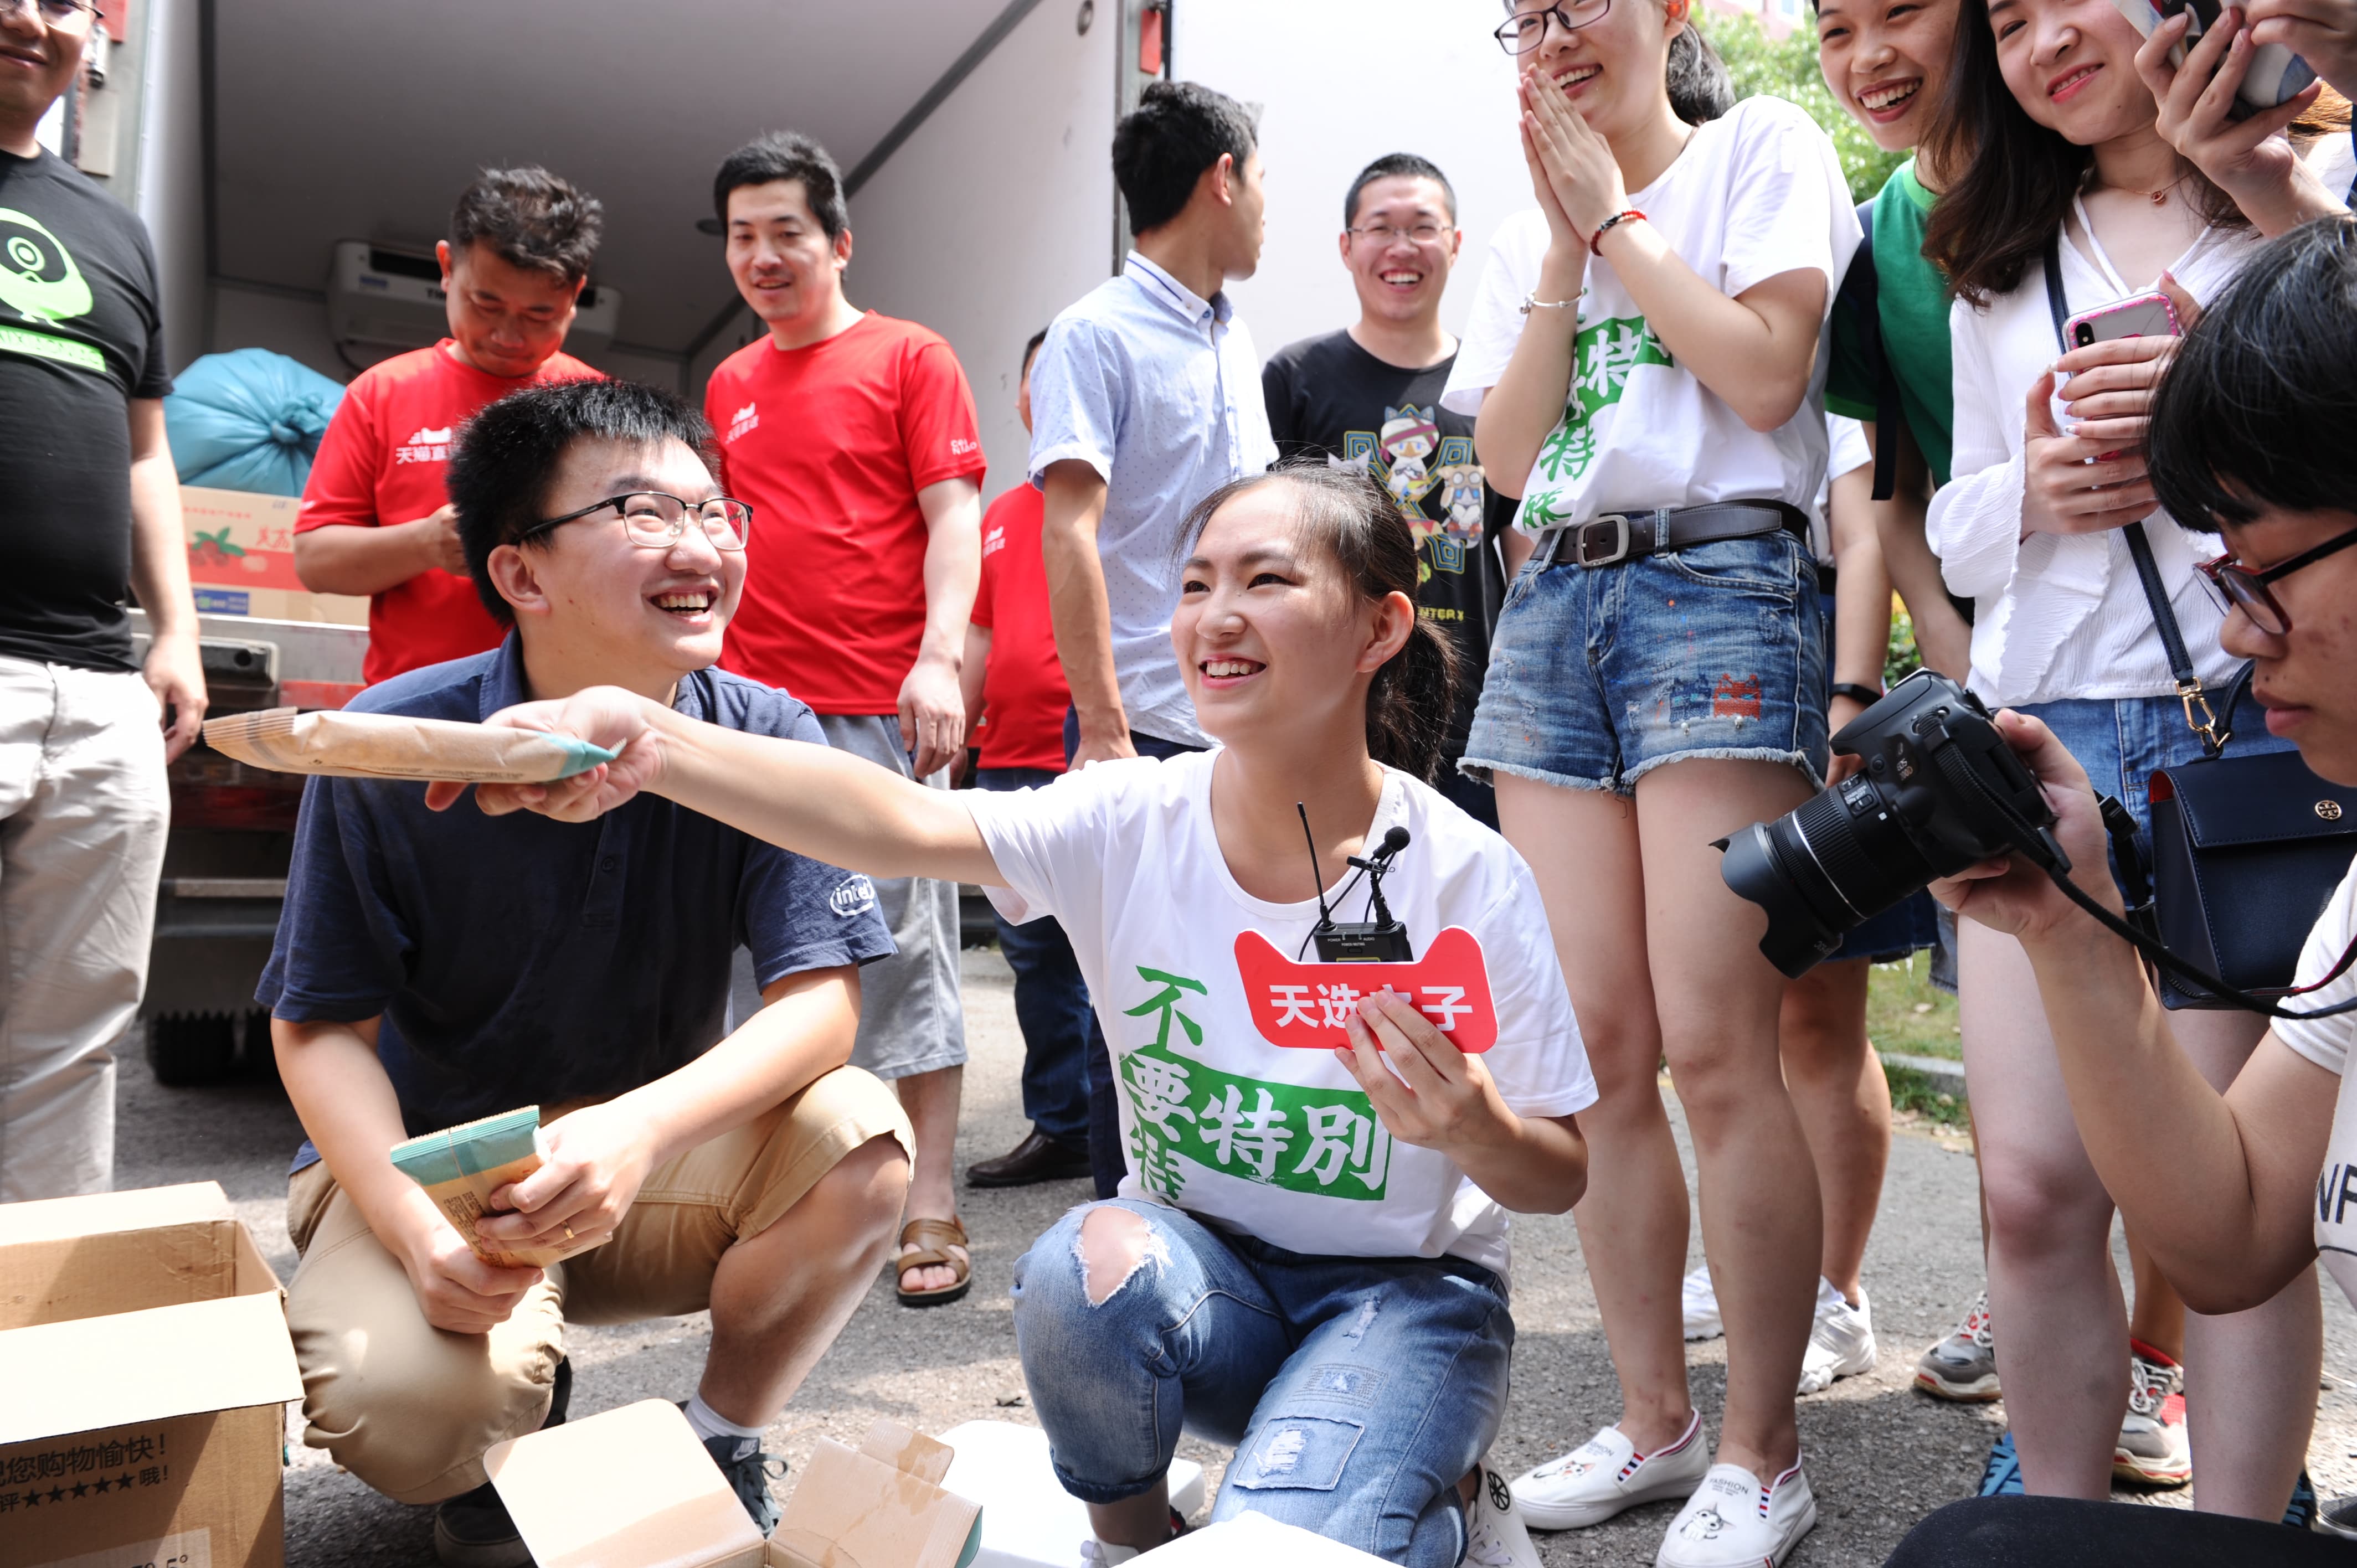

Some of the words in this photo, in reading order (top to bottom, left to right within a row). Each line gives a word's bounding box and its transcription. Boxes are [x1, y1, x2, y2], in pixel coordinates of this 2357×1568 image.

[833, 881, 871, 906] intel
[739, 1439, 758, 1453] NIKE
[1710, 1478, 1749, 1494] FASHION
